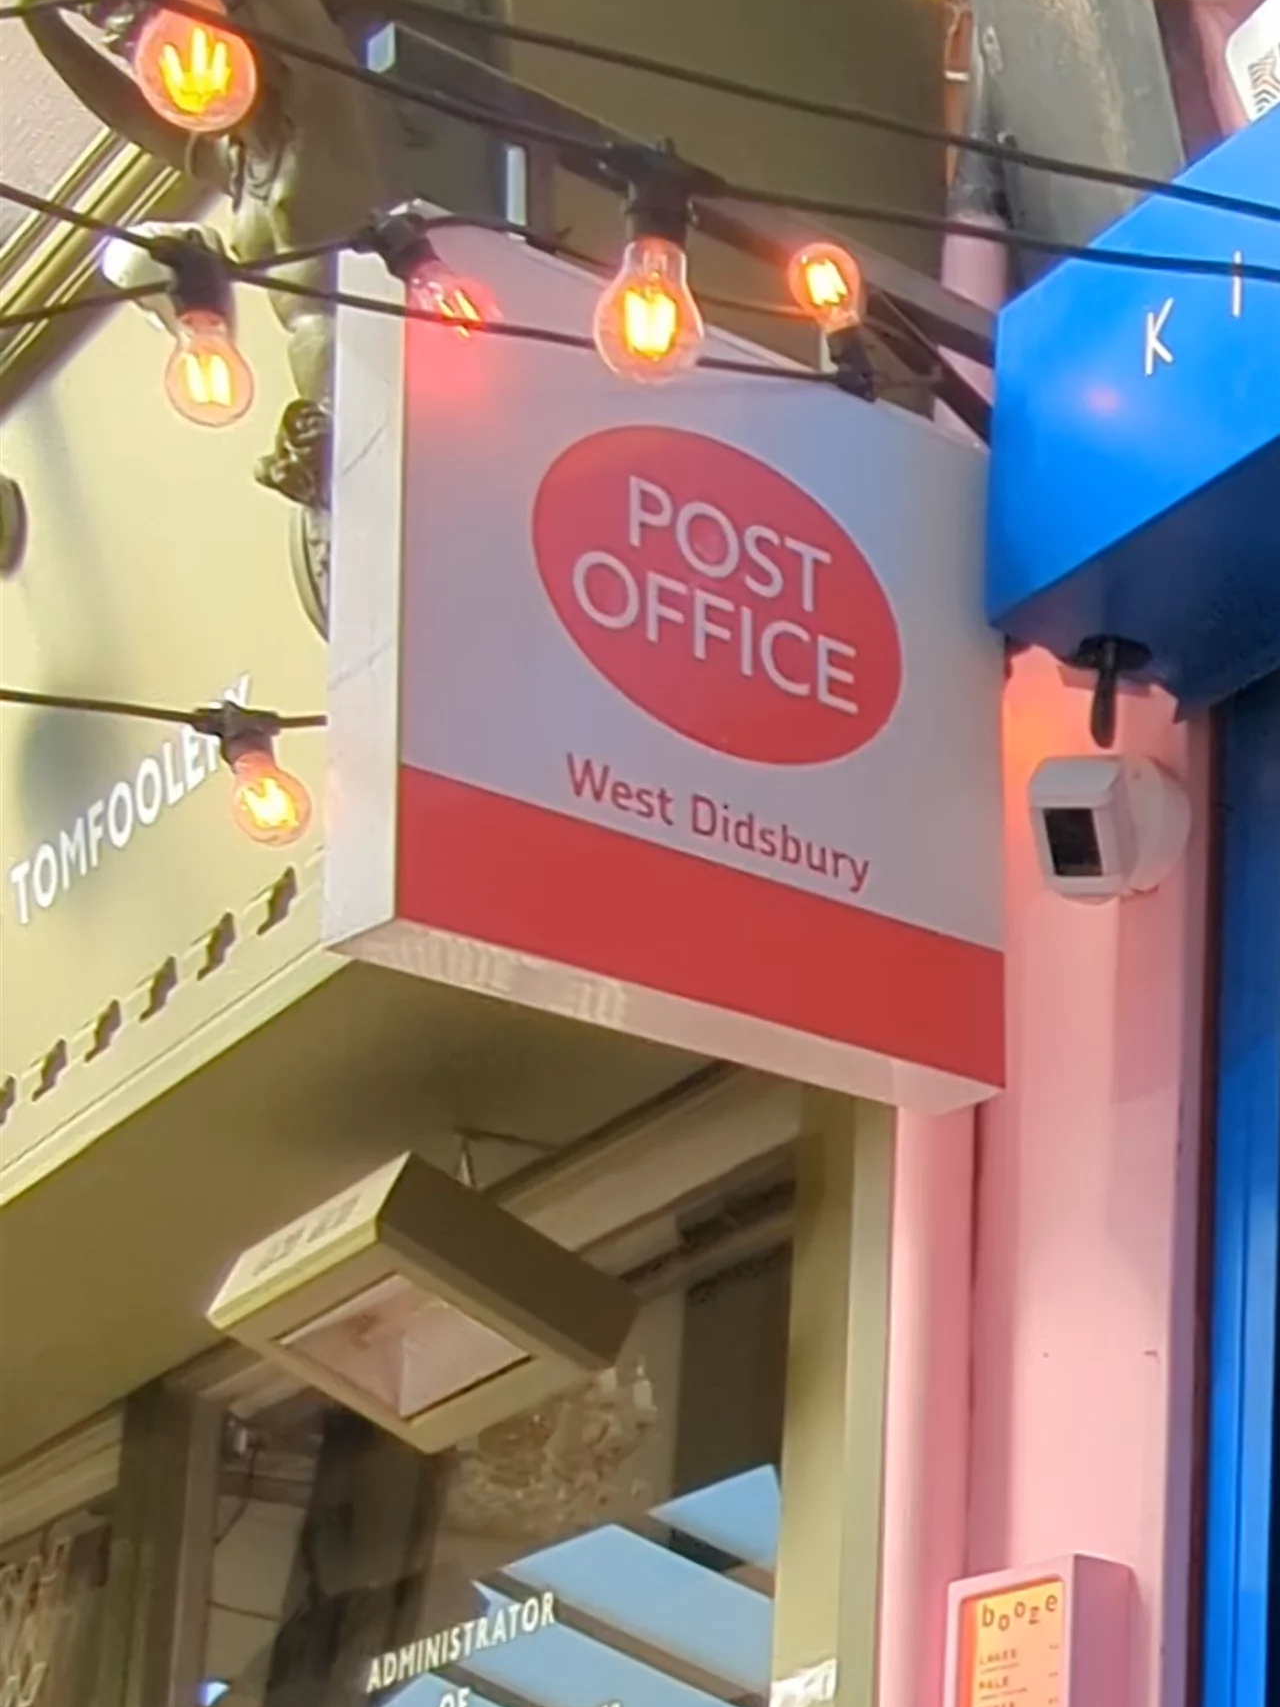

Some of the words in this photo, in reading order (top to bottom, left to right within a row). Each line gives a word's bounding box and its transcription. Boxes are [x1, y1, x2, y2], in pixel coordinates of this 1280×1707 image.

[628, 475, 832, 612] POST
[572, 550, 861, 716] OFFICE
[566, 752, 673, 827] West
[690, 793, 870, 894] Didsbury
[367, 1591, 557, 1694] ADMINISTRATOR
